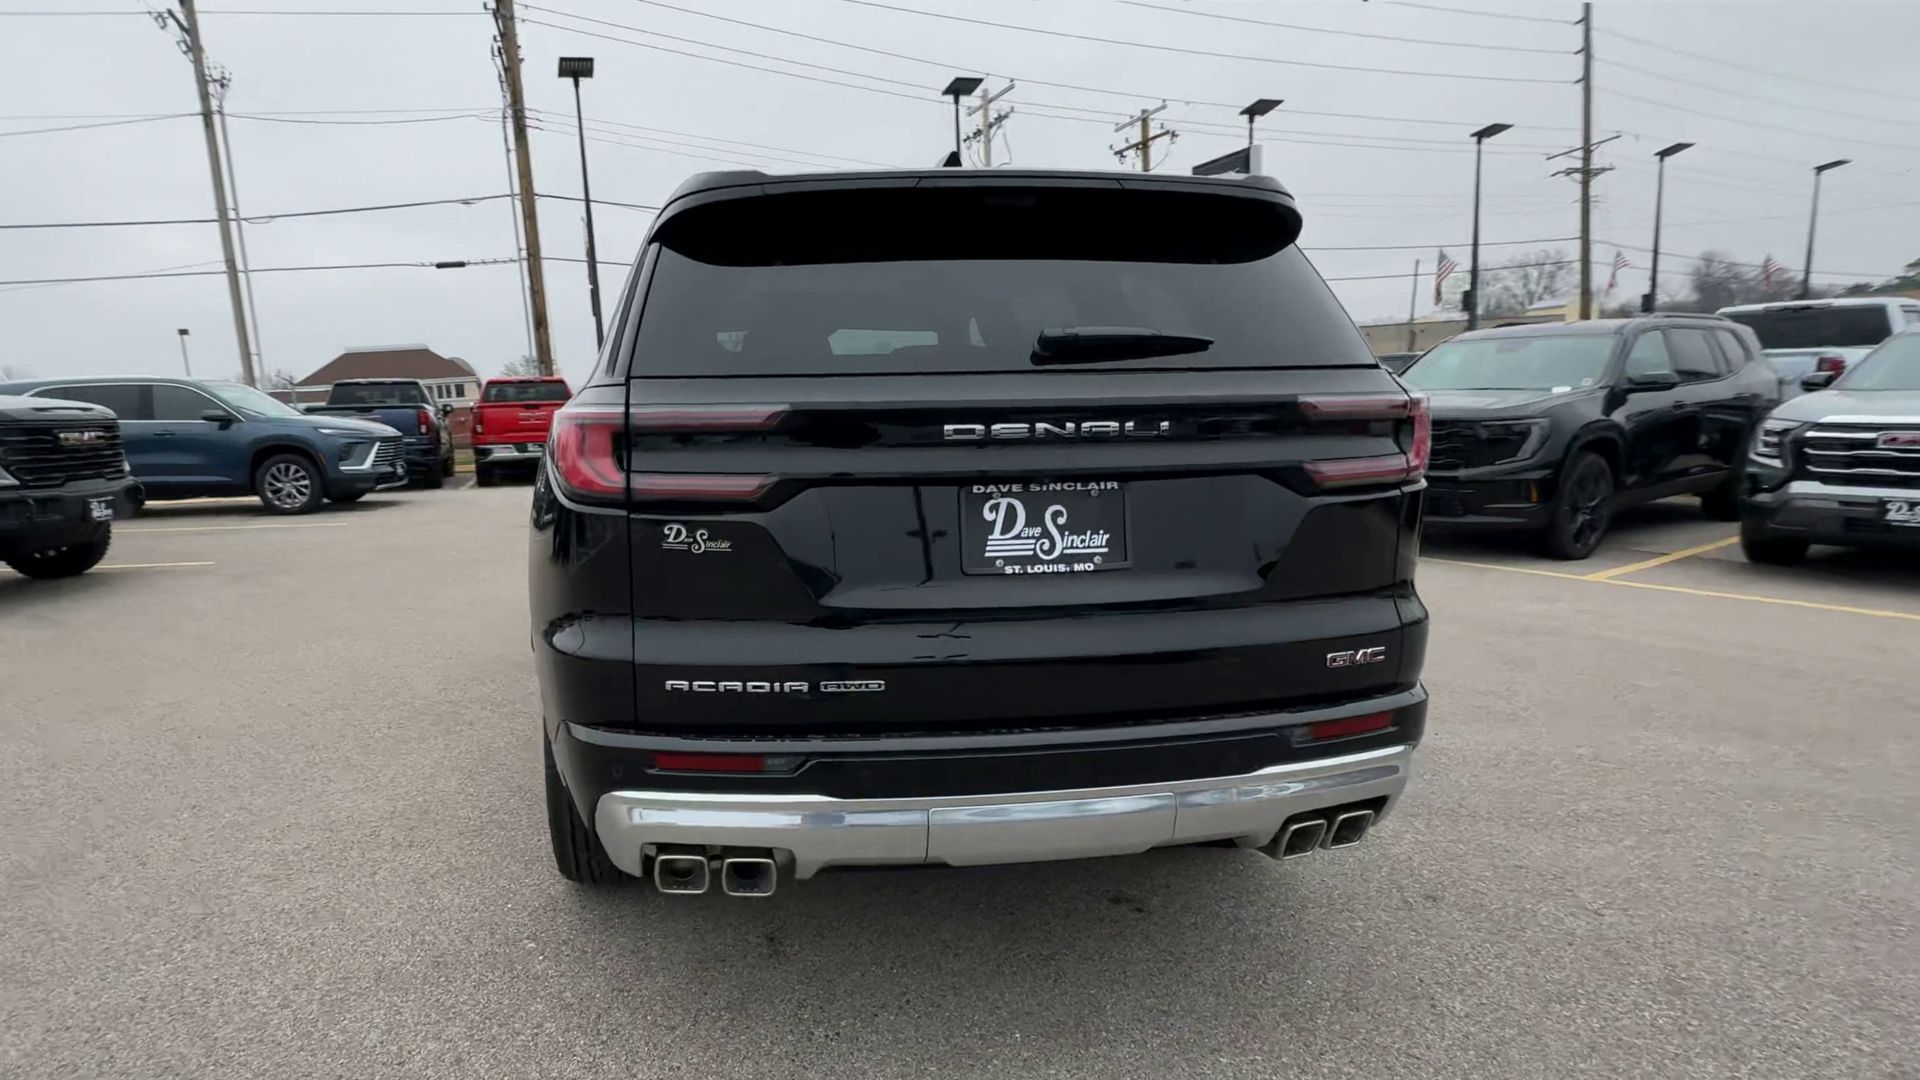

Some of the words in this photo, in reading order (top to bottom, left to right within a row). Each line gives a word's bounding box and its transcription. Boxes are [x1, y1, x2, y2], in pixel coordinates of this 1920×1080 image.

[943, 420, 1170, 440] DENALI
[972, 484, 1024, 494] DAVE
[1029, 481, 1119, 492] SINCLAIR
[982, 497, 1042, 540] Dave
[1035, 504, 1110, 560] Sinclair
[1004, 565, 1024, 574] ST.
[1027, 563, 1070, 573] LOUIS,
[1073, 562, 1095, 572] MO
[1327, 646, 1386, 668] GMC
[665, 680, 809, 692] ACADIA
[820, 680, 885, 692] AWD
